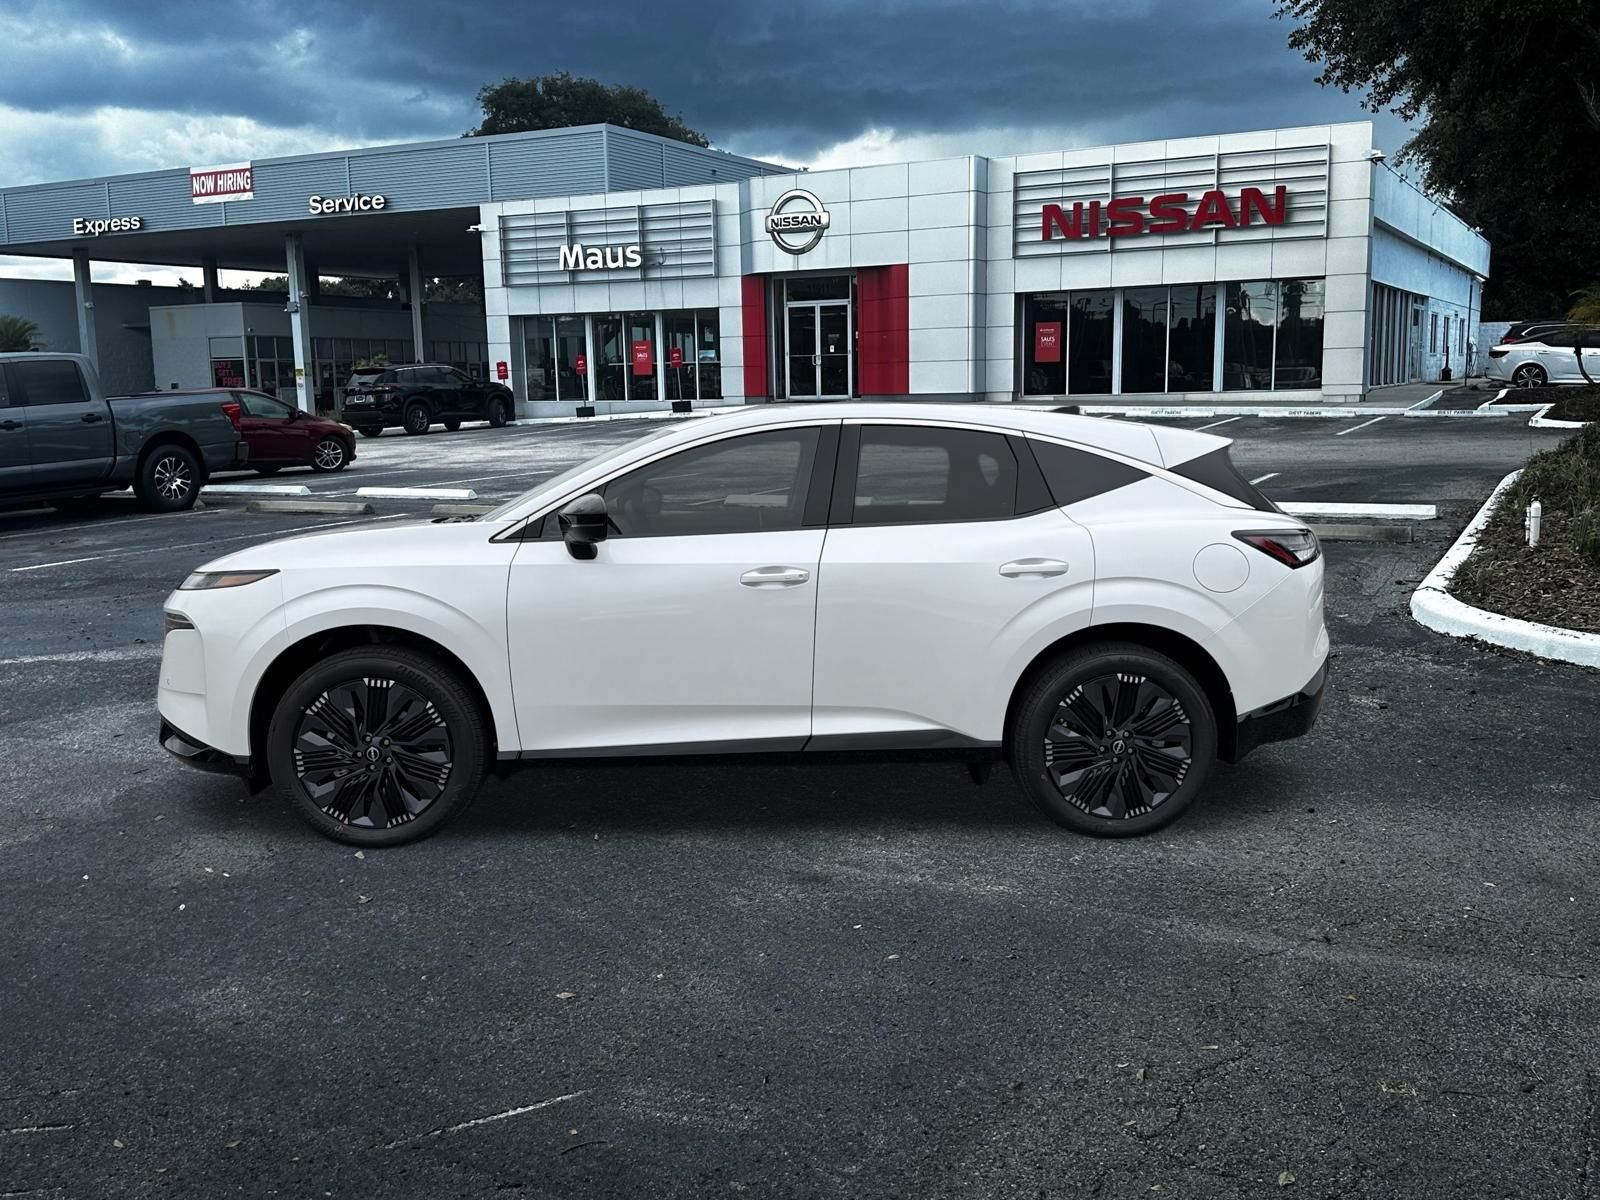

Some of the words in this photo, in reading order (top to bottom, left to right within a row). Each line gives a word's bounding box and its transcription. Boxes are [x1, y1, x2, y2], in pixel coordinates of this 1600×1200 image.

[192, 174, 215, 195] NOW
[217, 171, 251, 192] HIRING
[308, 193, 385, 215] Service
[1042, 185, 1287, 241] NISSAN
[73, 216, 141, 237] Express
[769, 214, 822, 230] NISSAN
[559, 243, 642, 271] Maus
